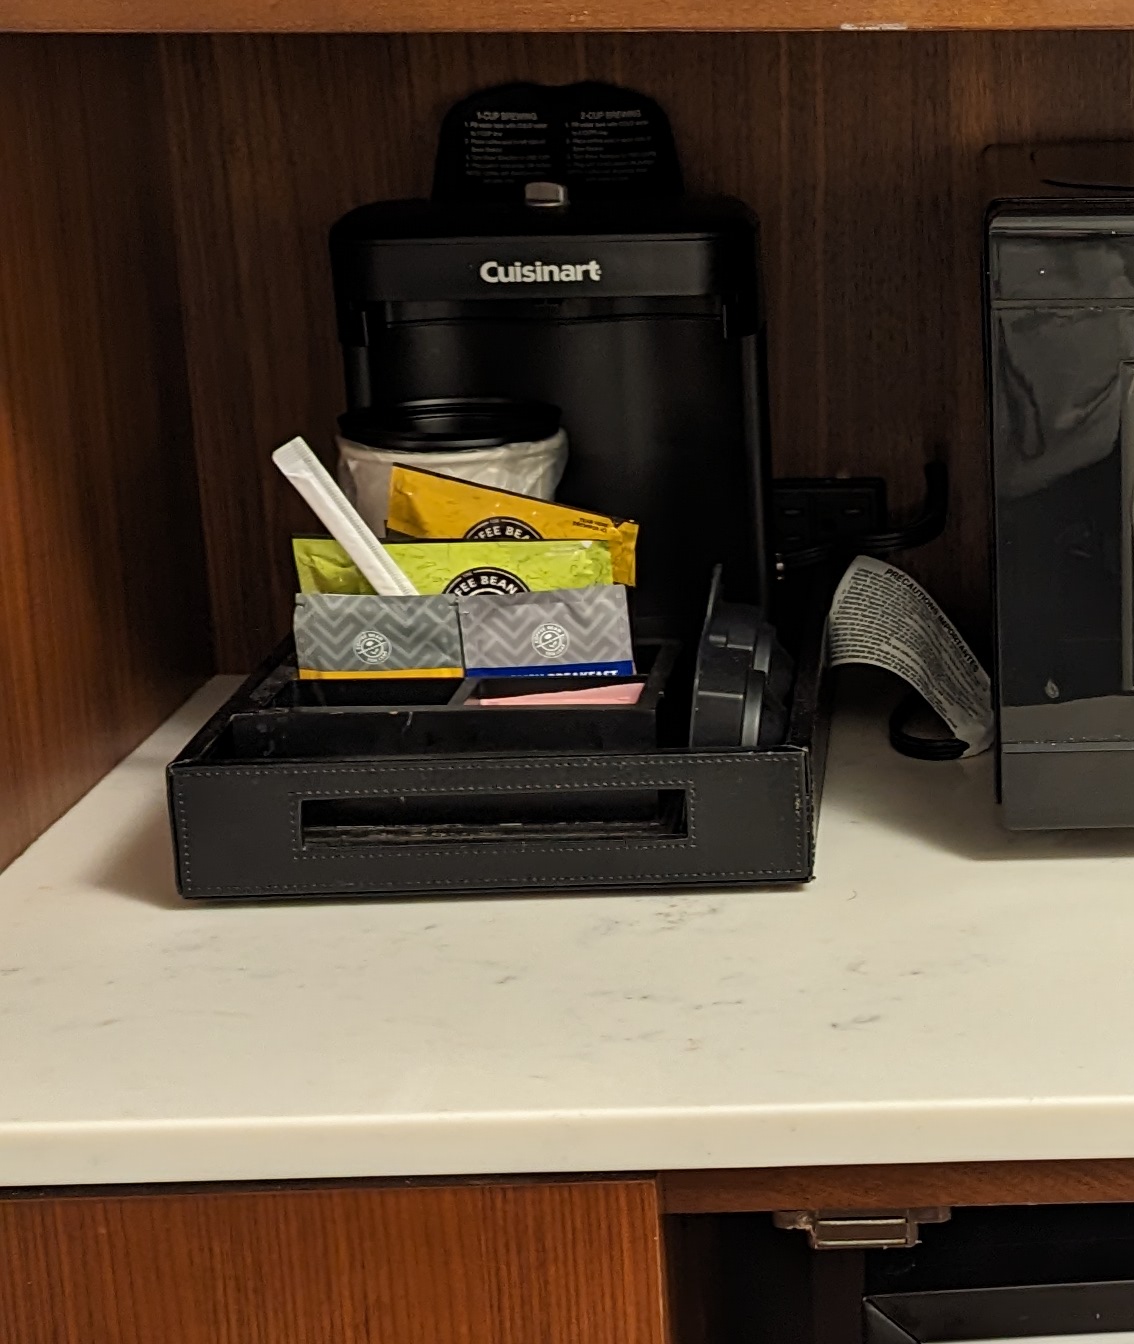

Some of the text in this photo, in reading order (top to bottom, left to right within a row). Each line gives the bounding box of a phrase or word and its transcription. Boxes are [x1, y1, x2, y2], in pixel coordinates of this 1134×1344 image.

[479, 260, 601, 283] Cuisinart
[473, 526, 502, 539] FEE
[454, 575, 518, 597] FEE BEAN
